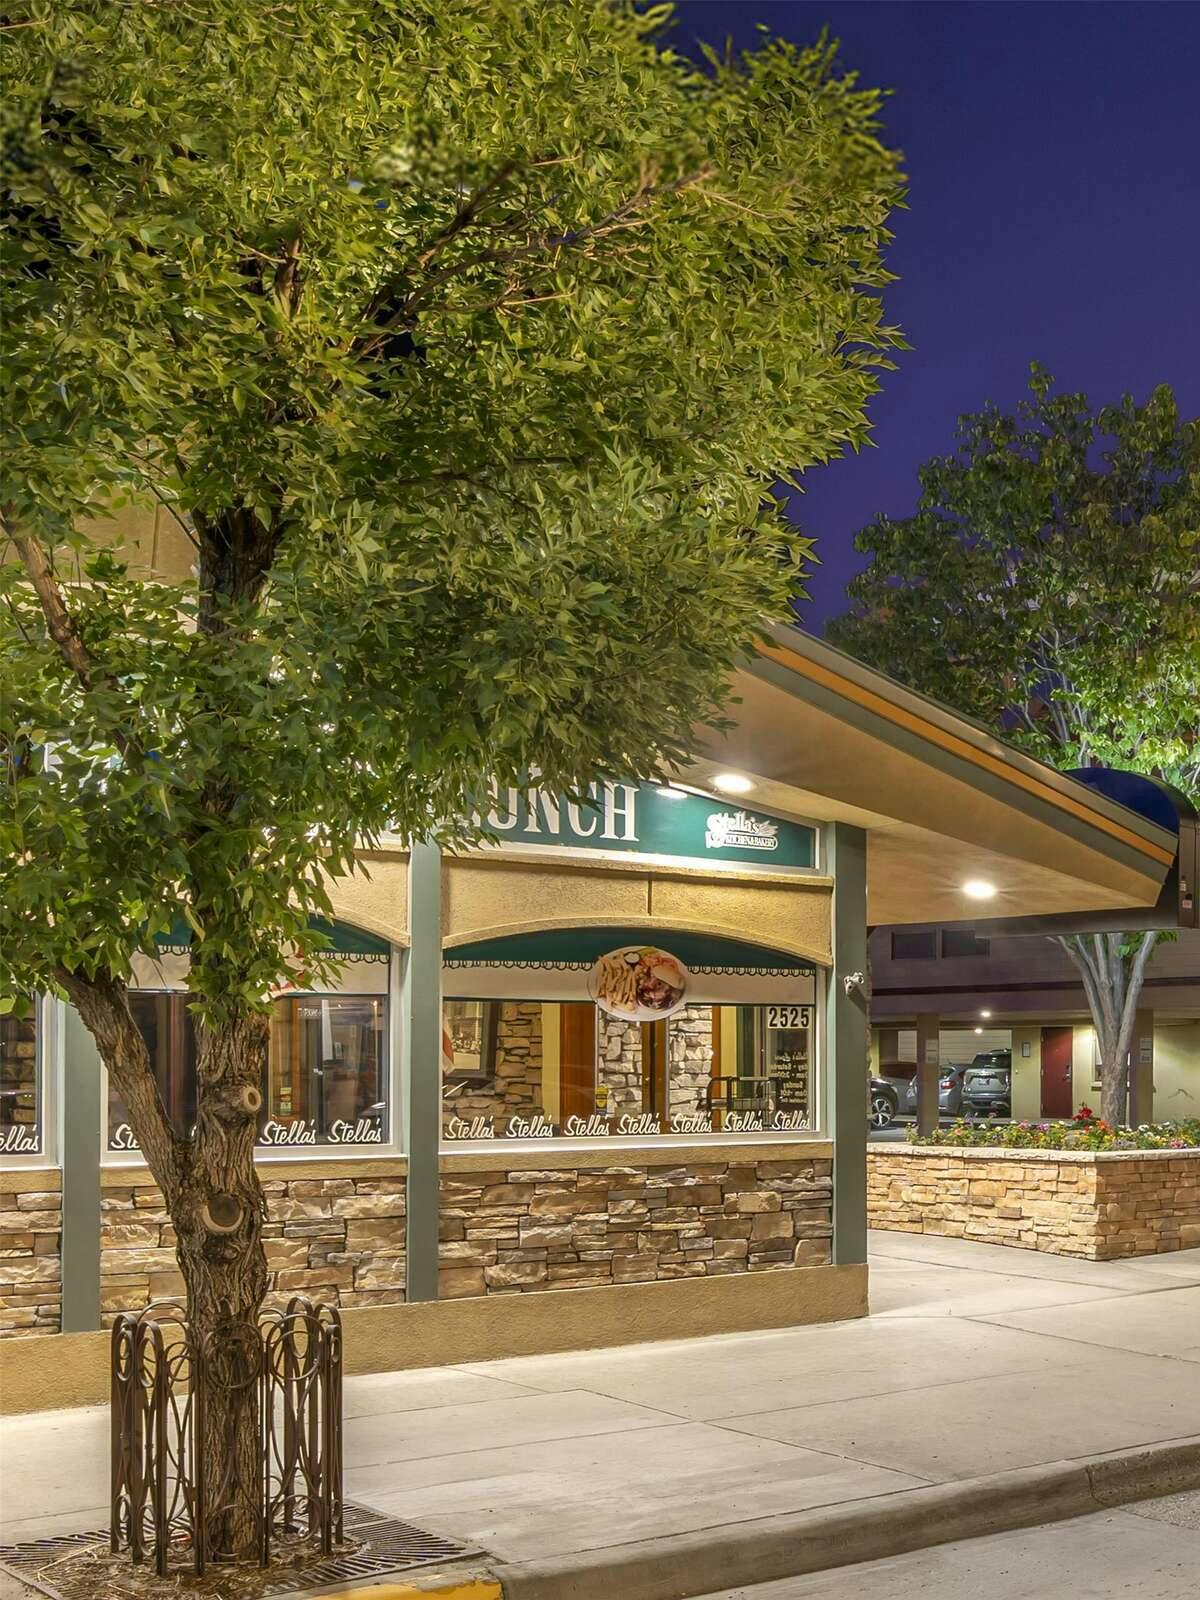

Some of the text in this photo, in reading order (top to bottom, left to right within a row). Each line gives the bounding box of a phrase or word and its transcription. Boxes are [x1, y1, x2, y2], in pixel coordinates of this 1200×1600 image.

[466, 764, 640, 842] UNCH
[706, 811, 761, 834] Stella's
[768, 1007, 809, 1028] 2525
[0, 1124, 39, 1152] ella's
[259, 1117, 382, 1145] Stella's Stella's
[444, 1109, 811, 1139] Stella's Stella's Stella's Stella's Stella's Stella's Stella's
